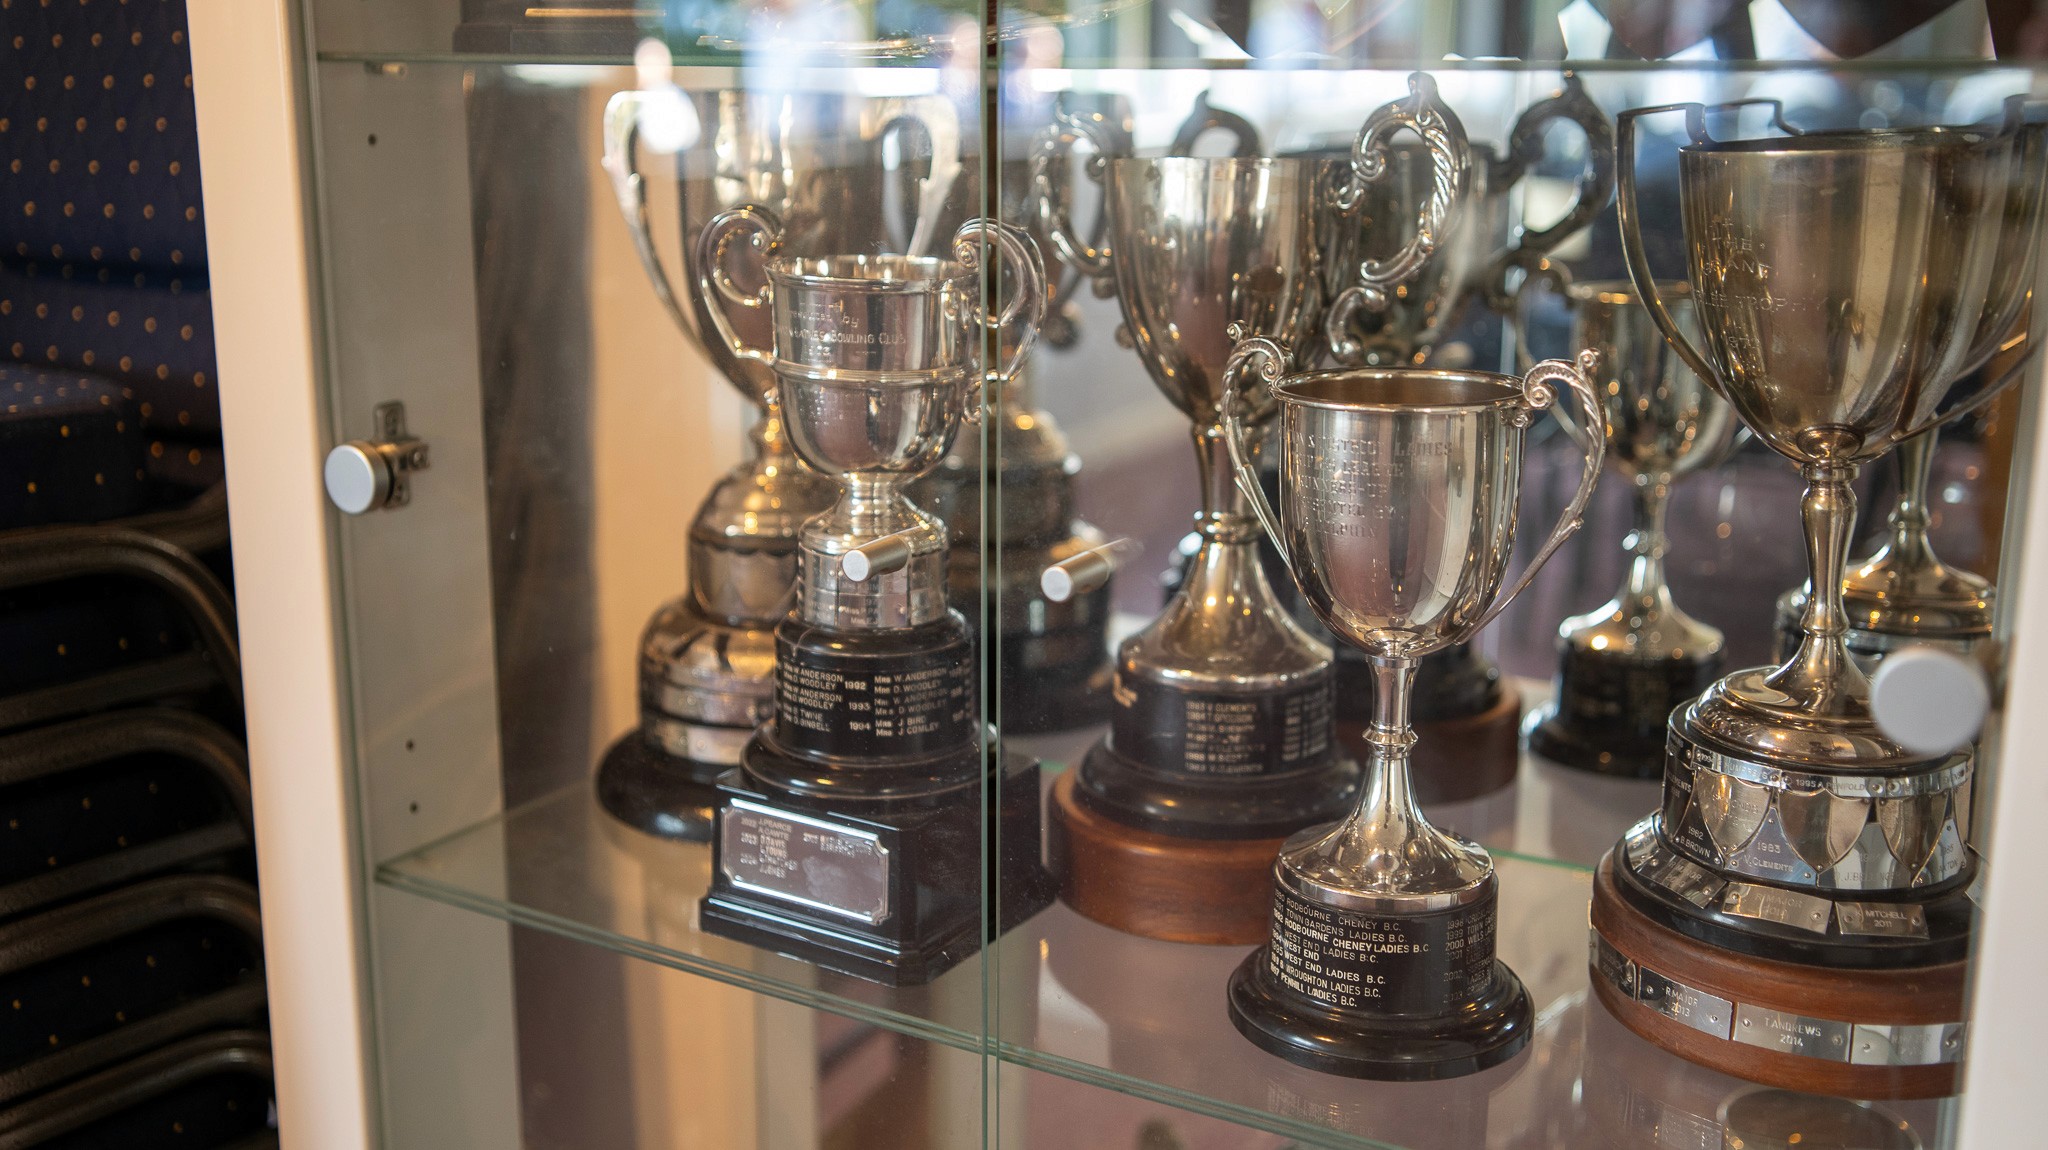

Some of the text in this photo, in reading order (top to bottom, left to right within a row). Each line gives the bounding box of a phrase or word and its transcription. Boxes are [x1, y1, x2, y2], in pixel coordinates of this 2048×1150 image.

[800, 669, 843, 683] ANDERSON
[799, 678, 836, 690] WOODLEY
[848, 702, 871, 711] 1993
[849, 721, 871, 731] 1994
[1796, 779, 1816, 788] 1995
[1286, 897, 1331, 922] RODBOURNE
[1338, 916, 1378, 930] CHENEY
[1865, 909, 1908, 920] MITCHELL
[1286, 908, 1304, 925] TOWN
[1304, 919, 1344, 937] GARDENS
[1349, 930, 1385, 943] LADIES
[1873, 919, 1893, 928] 2011
[1284, 917, 1330, 943] RODBOURNE
[1332, 938, 1373, 952] CHENEY
[1373, 943, 1410, 954] LADIES
[1283, 937, 1302, 954] WEST
[1303, 949, 1320, 961] END
[1284, 929, 1301, 945] WEST
[1323, 946, 1356, 961] LADIES
[1445, 939, 1465, 951] 2000
[1284, 949, 1303, 966] WEST
[1305, 961, 1322, 974] END
[1326, 967, 1360, 982] LADIES
[1286, 964, 1328, 989] WROUGHTON
[1330, 981, 1361, 996] LADIES
[1364, 987, 1381, 998] B.C.
[1280, 972, 1305, 993] PENHILL
[1307, 985, 1338, 1003] LADIES
[1340, 995, 1357, 1007] B.C.
[1780, 1033, 1804, 1047] 2014
